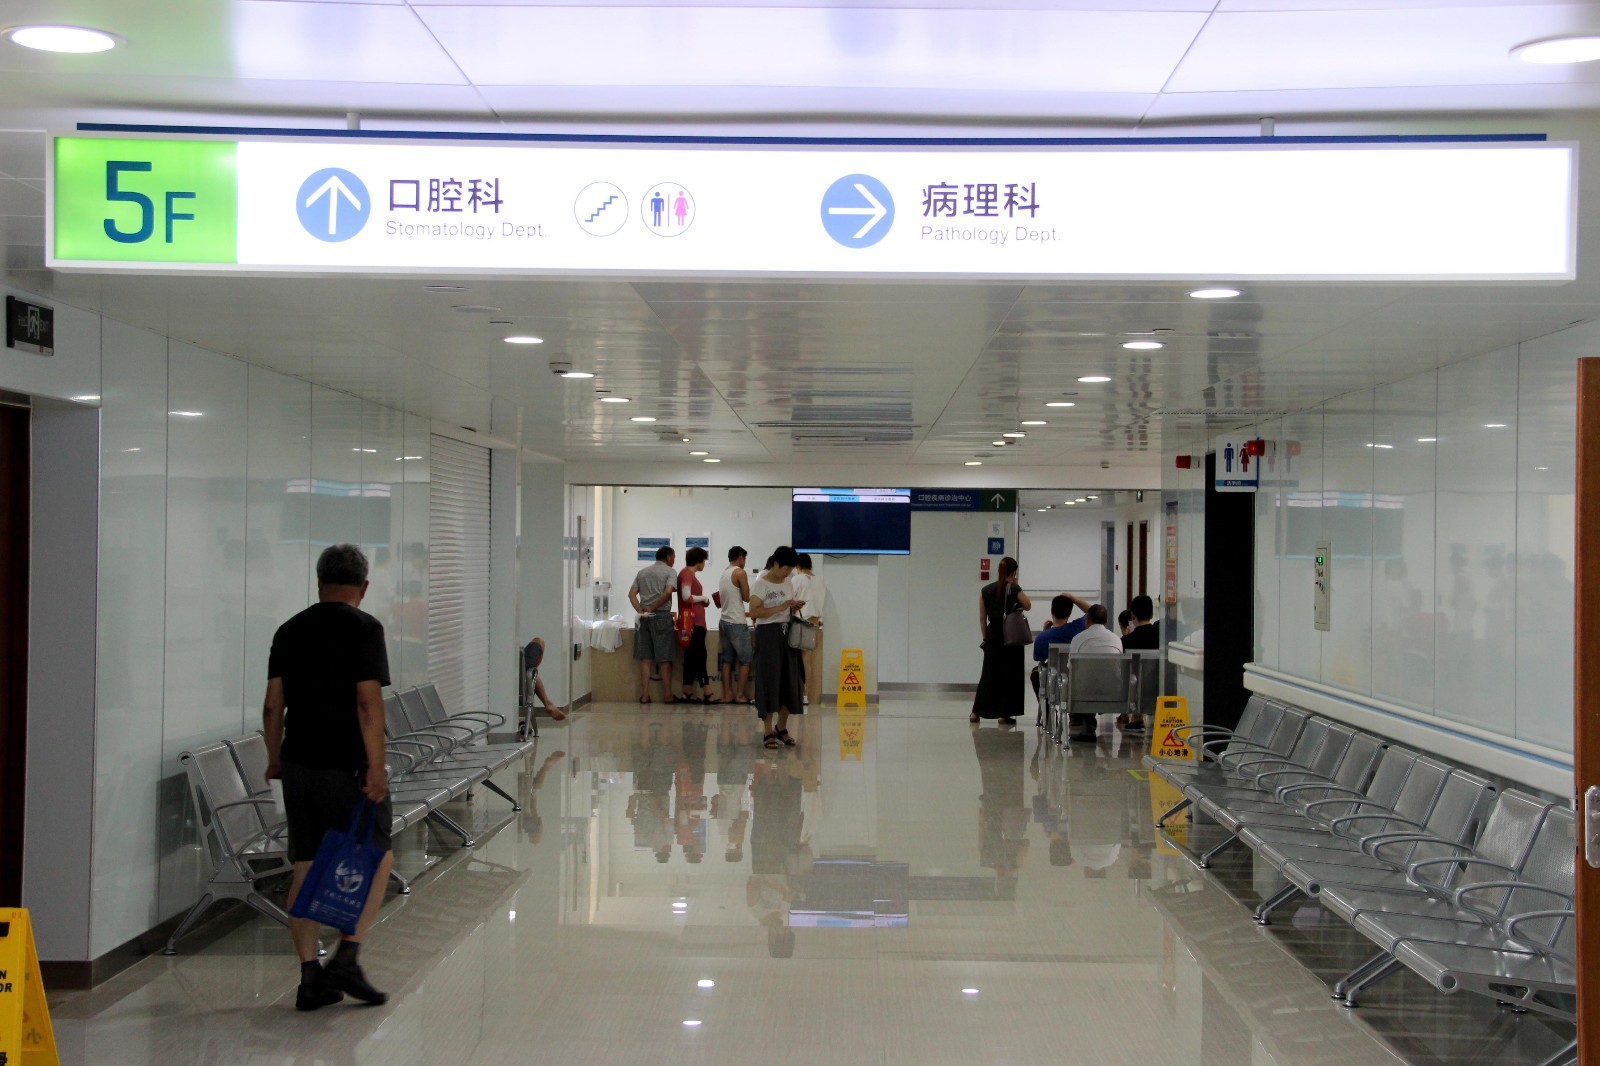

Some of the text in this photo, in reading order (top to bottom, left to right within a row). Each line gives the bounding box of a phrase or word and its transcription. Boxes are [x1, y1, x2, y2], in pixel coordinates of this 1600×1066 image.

[103, 160, 196, 244] 5F
[389, 177, 504, 214] 口腔科
[921, 181, 1040, 218] 病理科
[386, 220, 547, 240] Stomatology Dept.
[921, 226, 1062, 245] Pathology Dept.
[1159, 748, 1189, 757] 小心地滑
